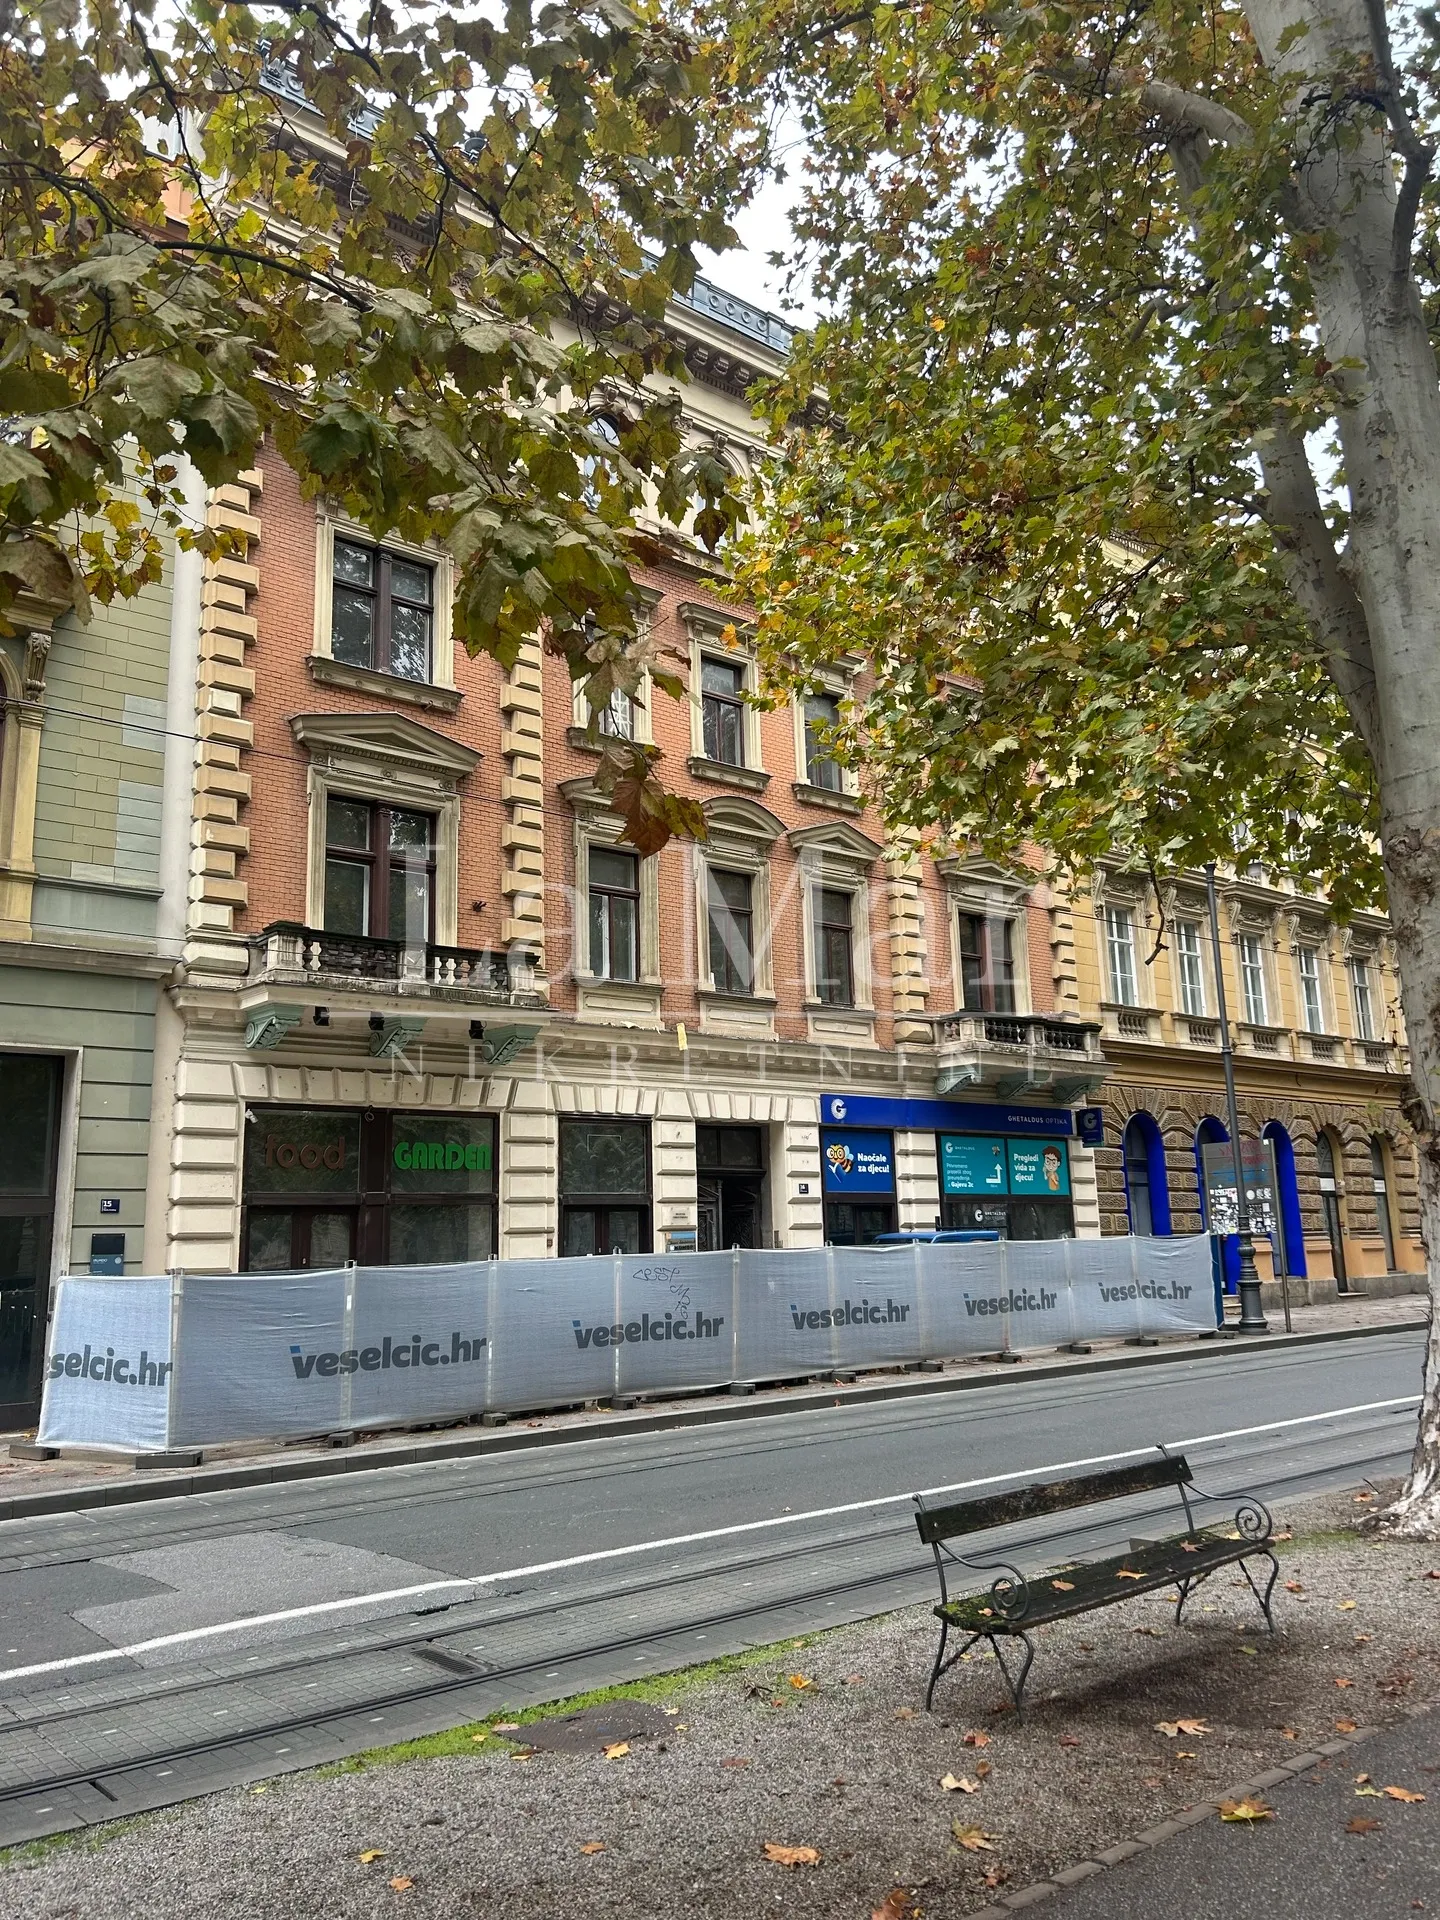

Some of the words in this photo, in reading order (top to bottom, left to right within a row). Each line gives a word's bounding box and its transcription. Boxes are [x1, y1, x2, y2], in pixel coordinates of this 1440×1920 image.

[1007, 1115, 1043, 1123] GHETALDUS
[1045, 1117, 1067, 1125] OPTIKA
[265, 1134, 346, 1170] food
[857, 1152, 887, 1162] Naočale
[1013, 1153, 1039, 1163] Pregledi
[858, 1165, 867, 1173] za
[867, 1164, 890, 1175] djecu!
[1014, 1163, 1027, 1171] vida
[1014, 1173, 1034, 1182] djecu!
[1097, 1278, 1193, 1303] veselcic.hr
[963, 1287, 1058, 1316] veselcic.hr
[790, 1298, 910, 1330] veselcic.hr
[572, 1311, 725, 1349] veselcic.hr
[289, 1331, 487, 1380] veselcic.hr
